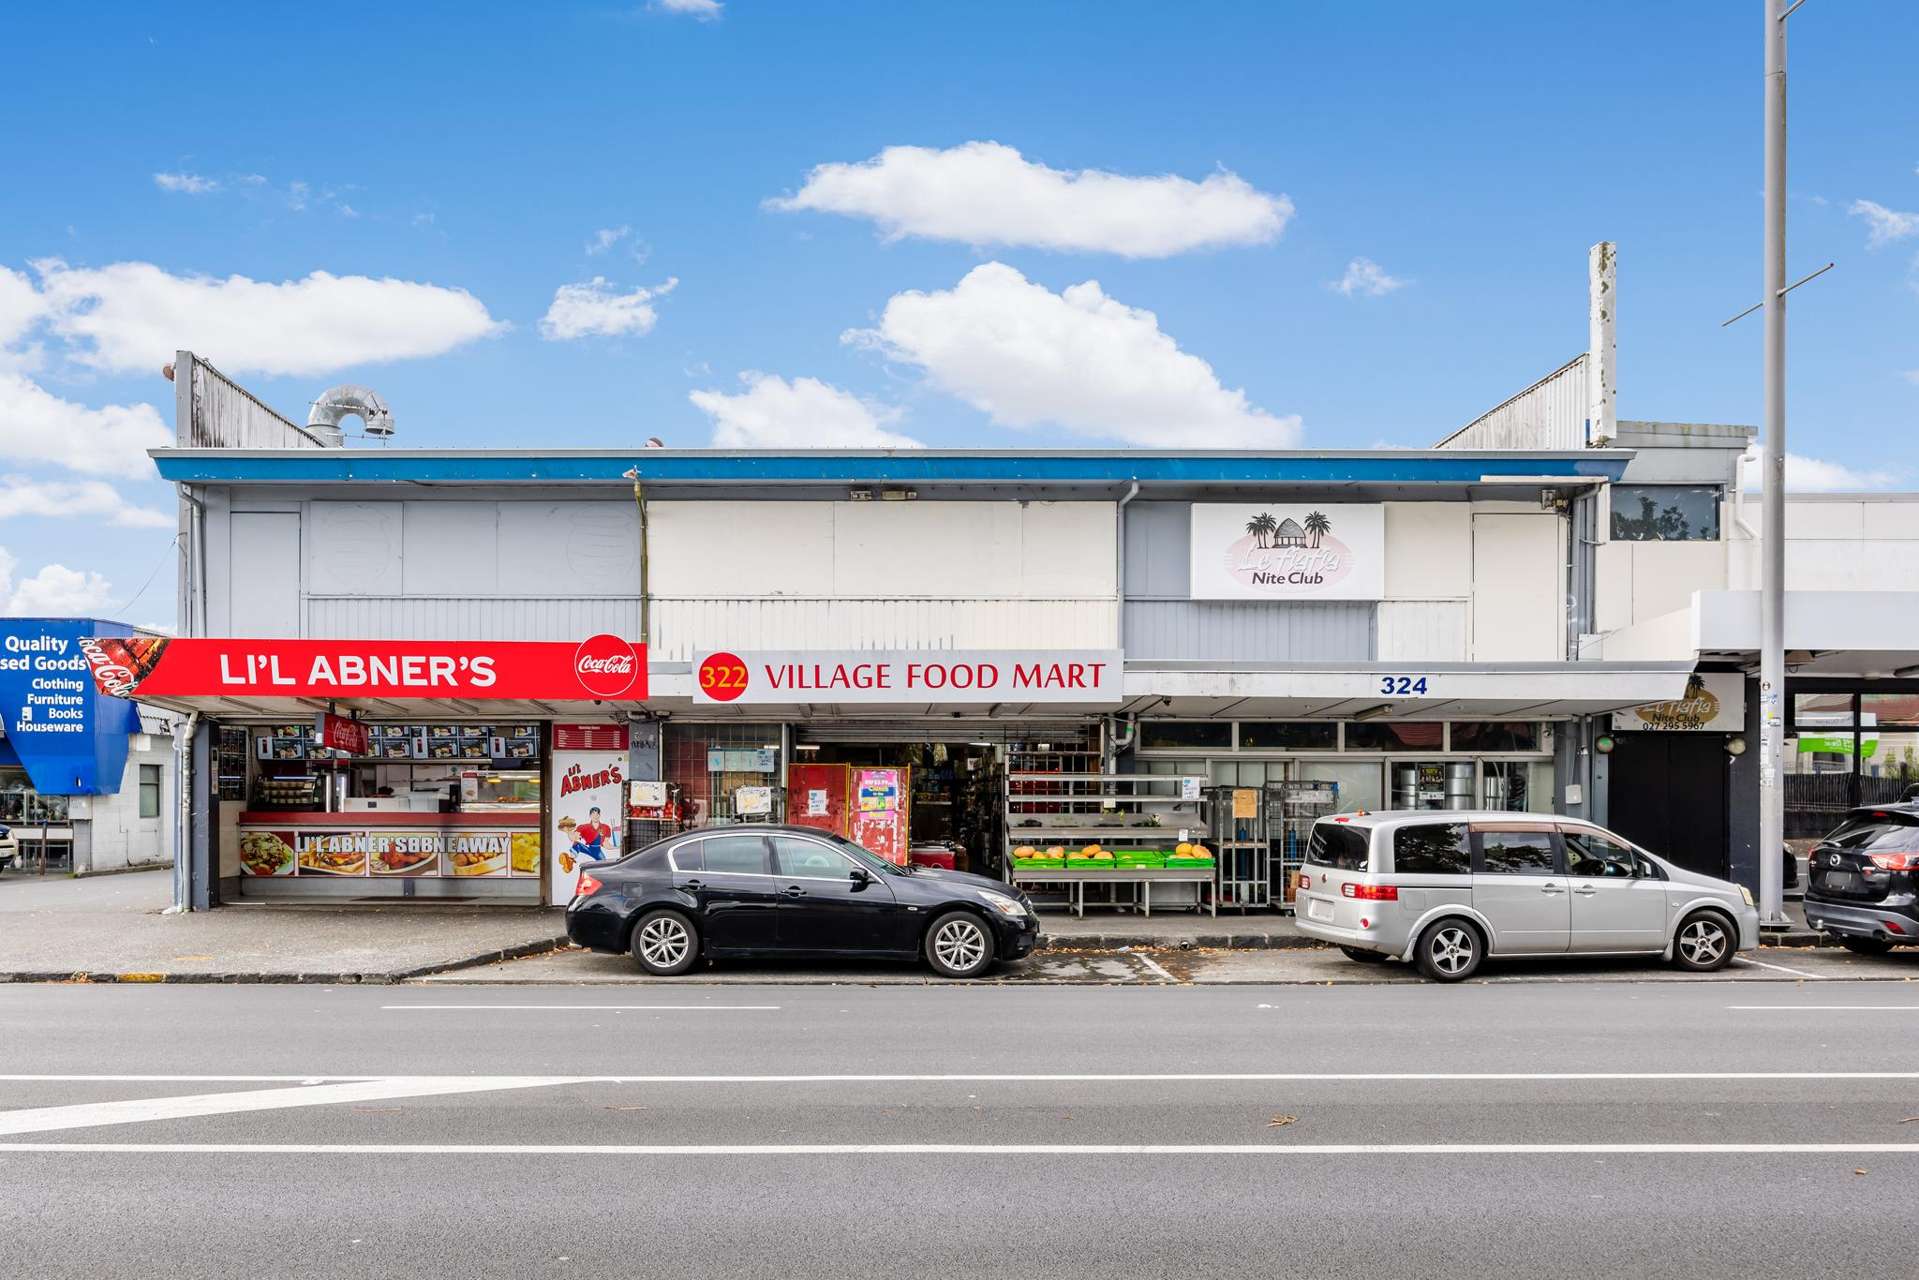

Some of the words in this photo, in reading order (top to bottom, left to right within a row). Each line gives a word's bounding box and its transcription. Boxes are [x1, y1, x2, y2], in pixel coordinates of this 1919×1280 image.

[1252, 572, 1286, 585] Nite
[1288, 572, 1324, 585] Club
[5, 635, 68, 655] Quality
[34, 655, 87, 671] Goods
[578, 654, 634, 674] Coca-Cola
[220, 655, 297, 685] LI'L
[307, 655, 497, 687] ABNER'S
[700, 662, 748, 690] 322
[765, 662, 889, 689] VILLAGE
[907, 662, 999, 689] FOOD
[1012, 662, 1105, 689] MART
[32, 678, 84, 692] Clothing
[1381, 676, 1427, 695] 324
[27, 693, 84, 705] Furniture
[48, 708, 84, 719] Books
[1653, 714, 1674, 722] Nite
[16, 720, 84, 732] Houseware
[1643, 722, 1660, 731] 027
[1663, 721, 1680, 730] 295
[1682, 721, 1705, 730] 5967
[561, 764, 623, 797] ABNER'S
